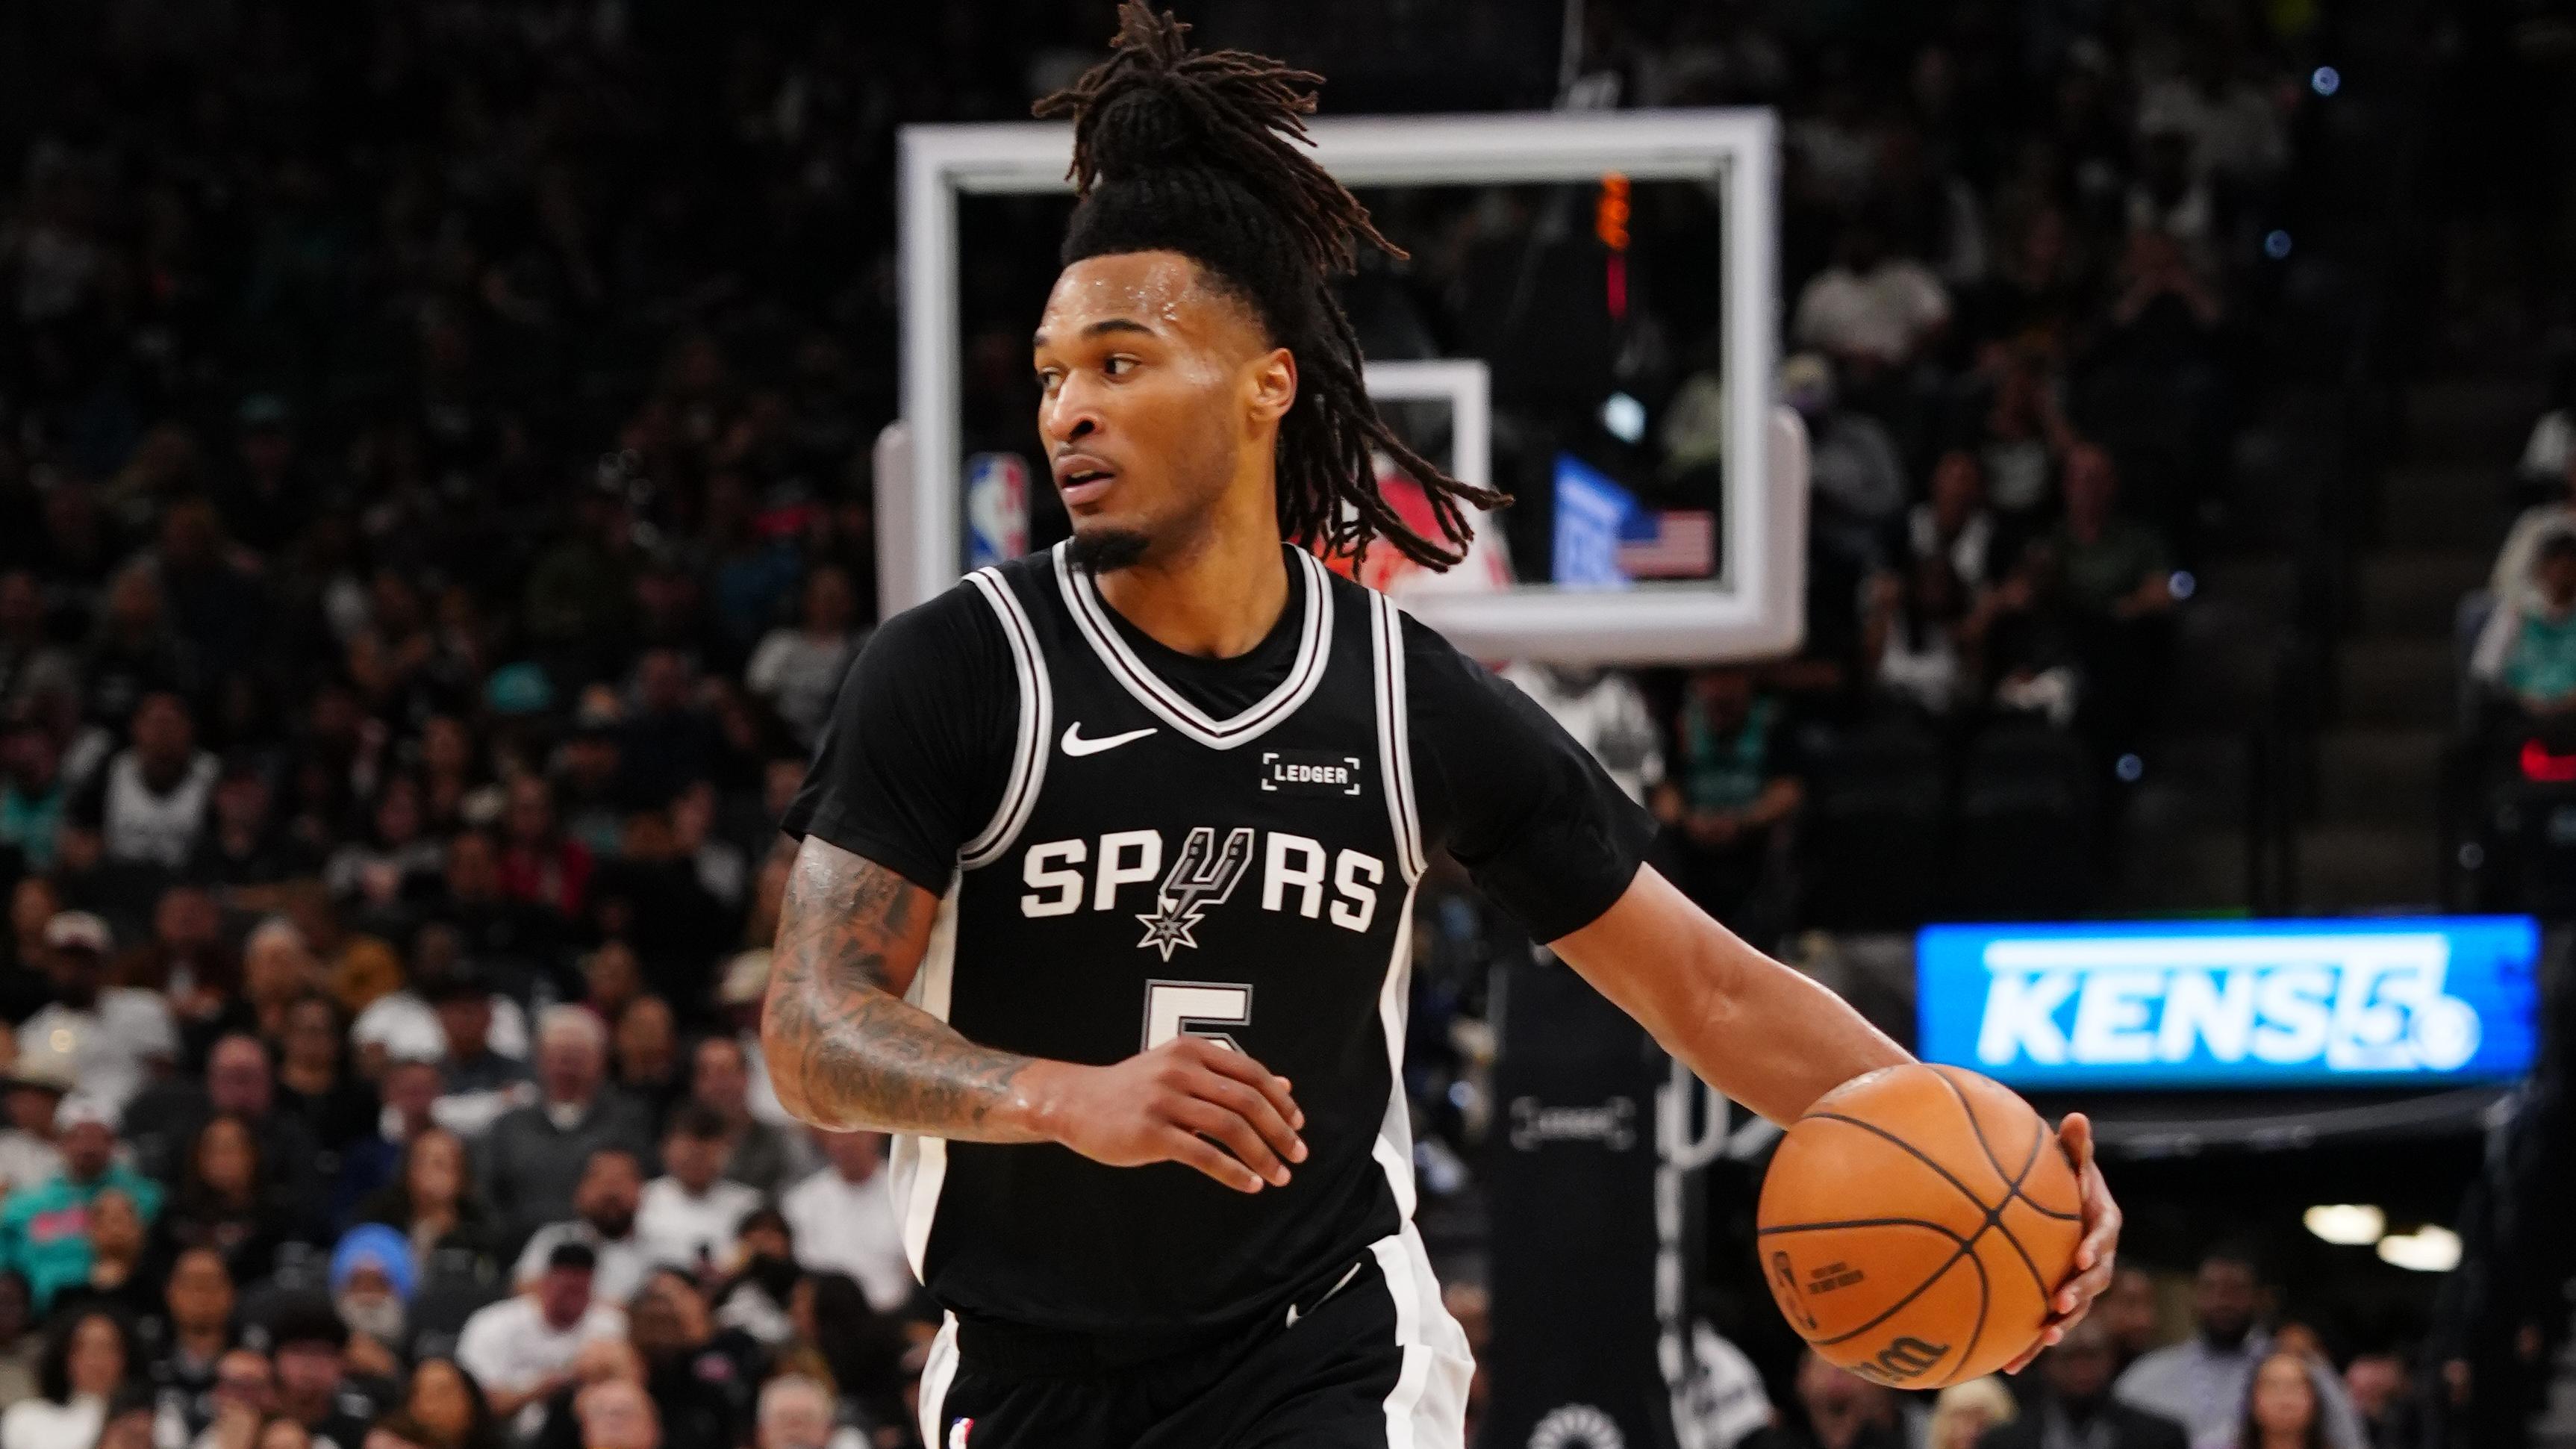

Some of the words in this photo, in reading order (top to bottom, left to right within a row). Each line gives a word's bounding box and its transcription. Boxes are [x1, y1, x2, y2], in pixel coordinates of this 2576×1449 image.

[1274, 764, 1349, 785] LEDGER
[1020, 827, 1385, 942] SPURS
[1976, 967, 2336, 1066] KENS
